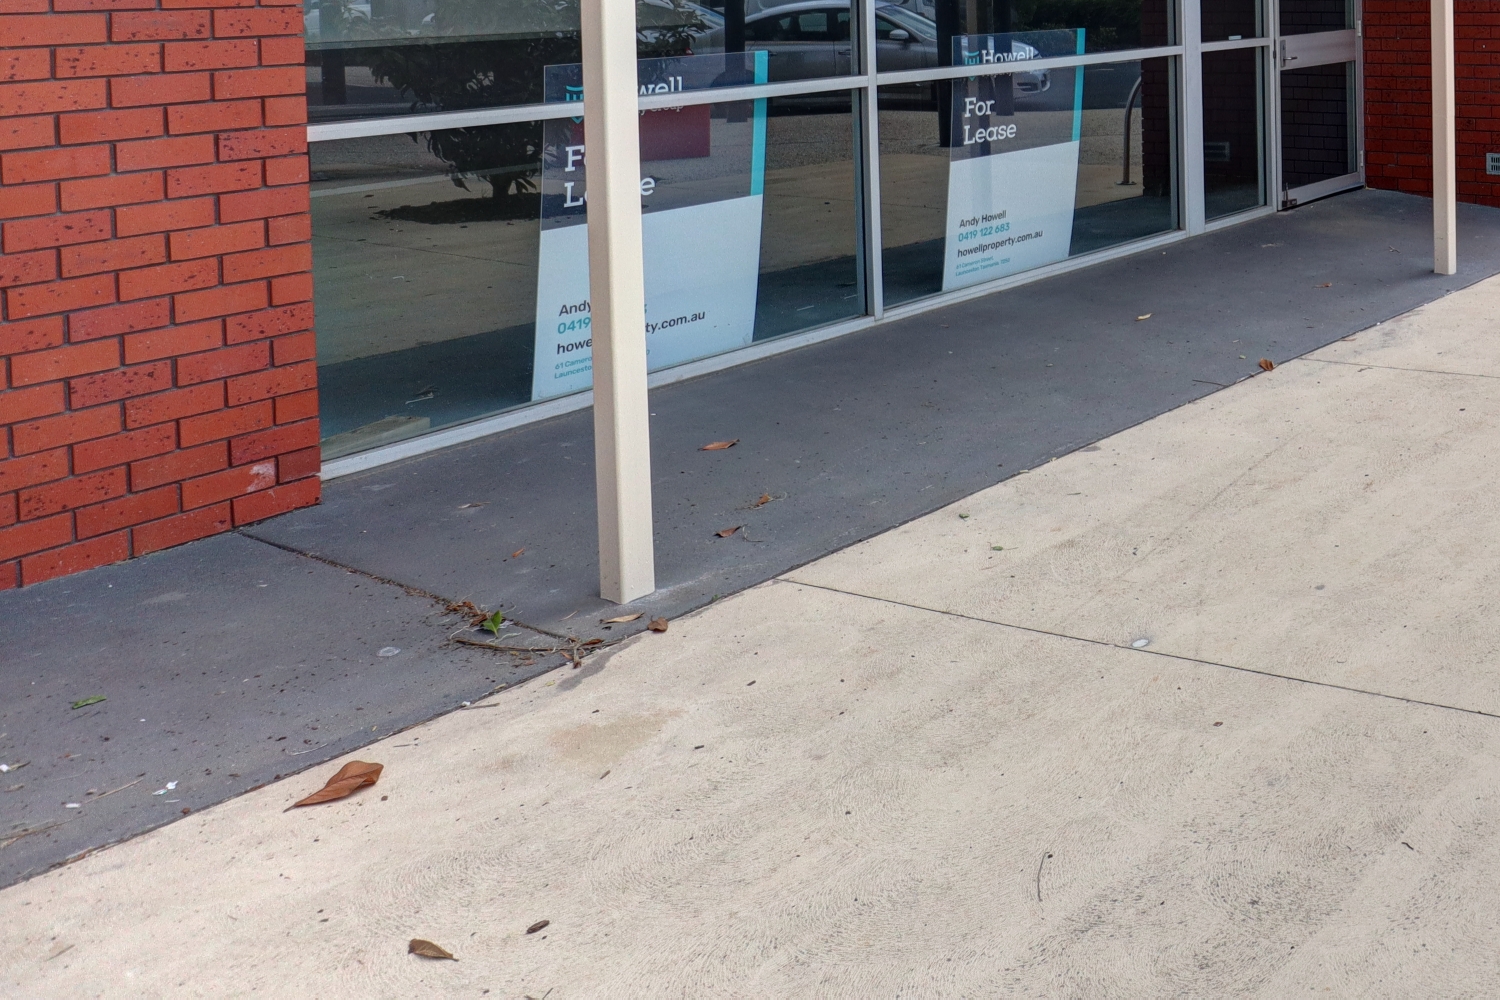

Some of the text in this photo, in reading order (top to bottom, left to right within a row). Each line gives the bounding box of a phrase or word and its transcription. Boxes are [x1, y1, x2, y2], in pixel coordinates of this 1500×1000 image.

[981, 47, 1034, 64] Howell
[964, 97, 995, 118] For
[963, 124, 1017, 146] Lease
[959, 210, 1007, 228] Andy Howell
[958, 222, 1010, 242] 0419 122 683
[957, 230, 1043, 258] howellproperty.com.au
[557, 316, 592, 335] 0419
[554, 361, 564, 370] 61
